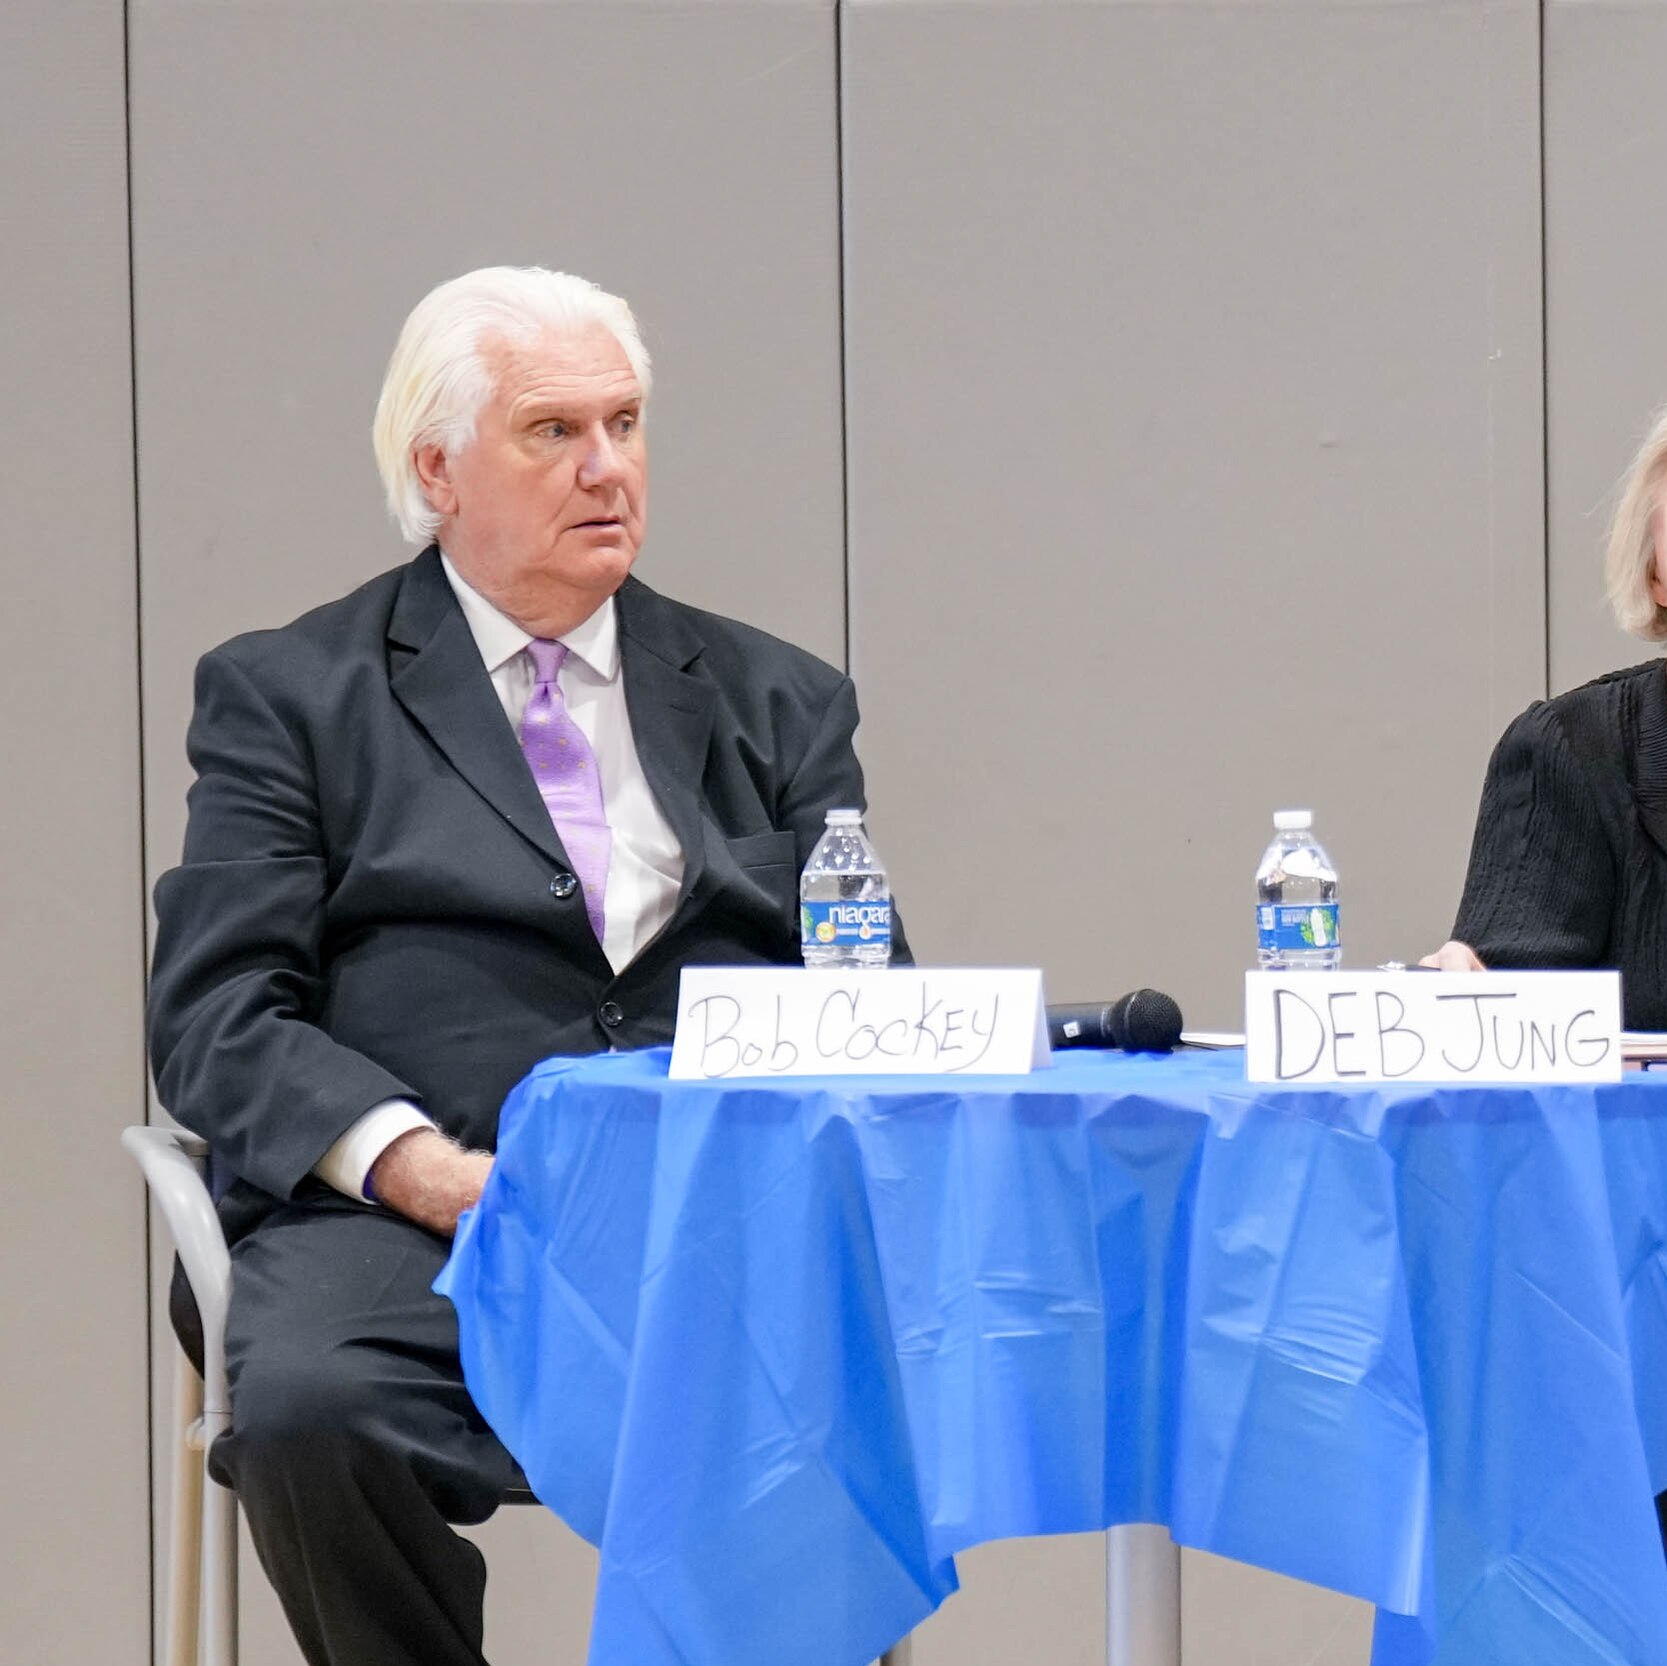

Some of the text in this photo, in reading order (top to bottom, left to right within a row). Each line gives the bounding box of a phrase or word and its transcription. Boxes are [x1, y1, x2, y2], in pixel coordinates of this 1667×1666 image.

[690, 995, 799, 1078] Bob
[1274, 990, 1610, 1080] DEB JUNG
